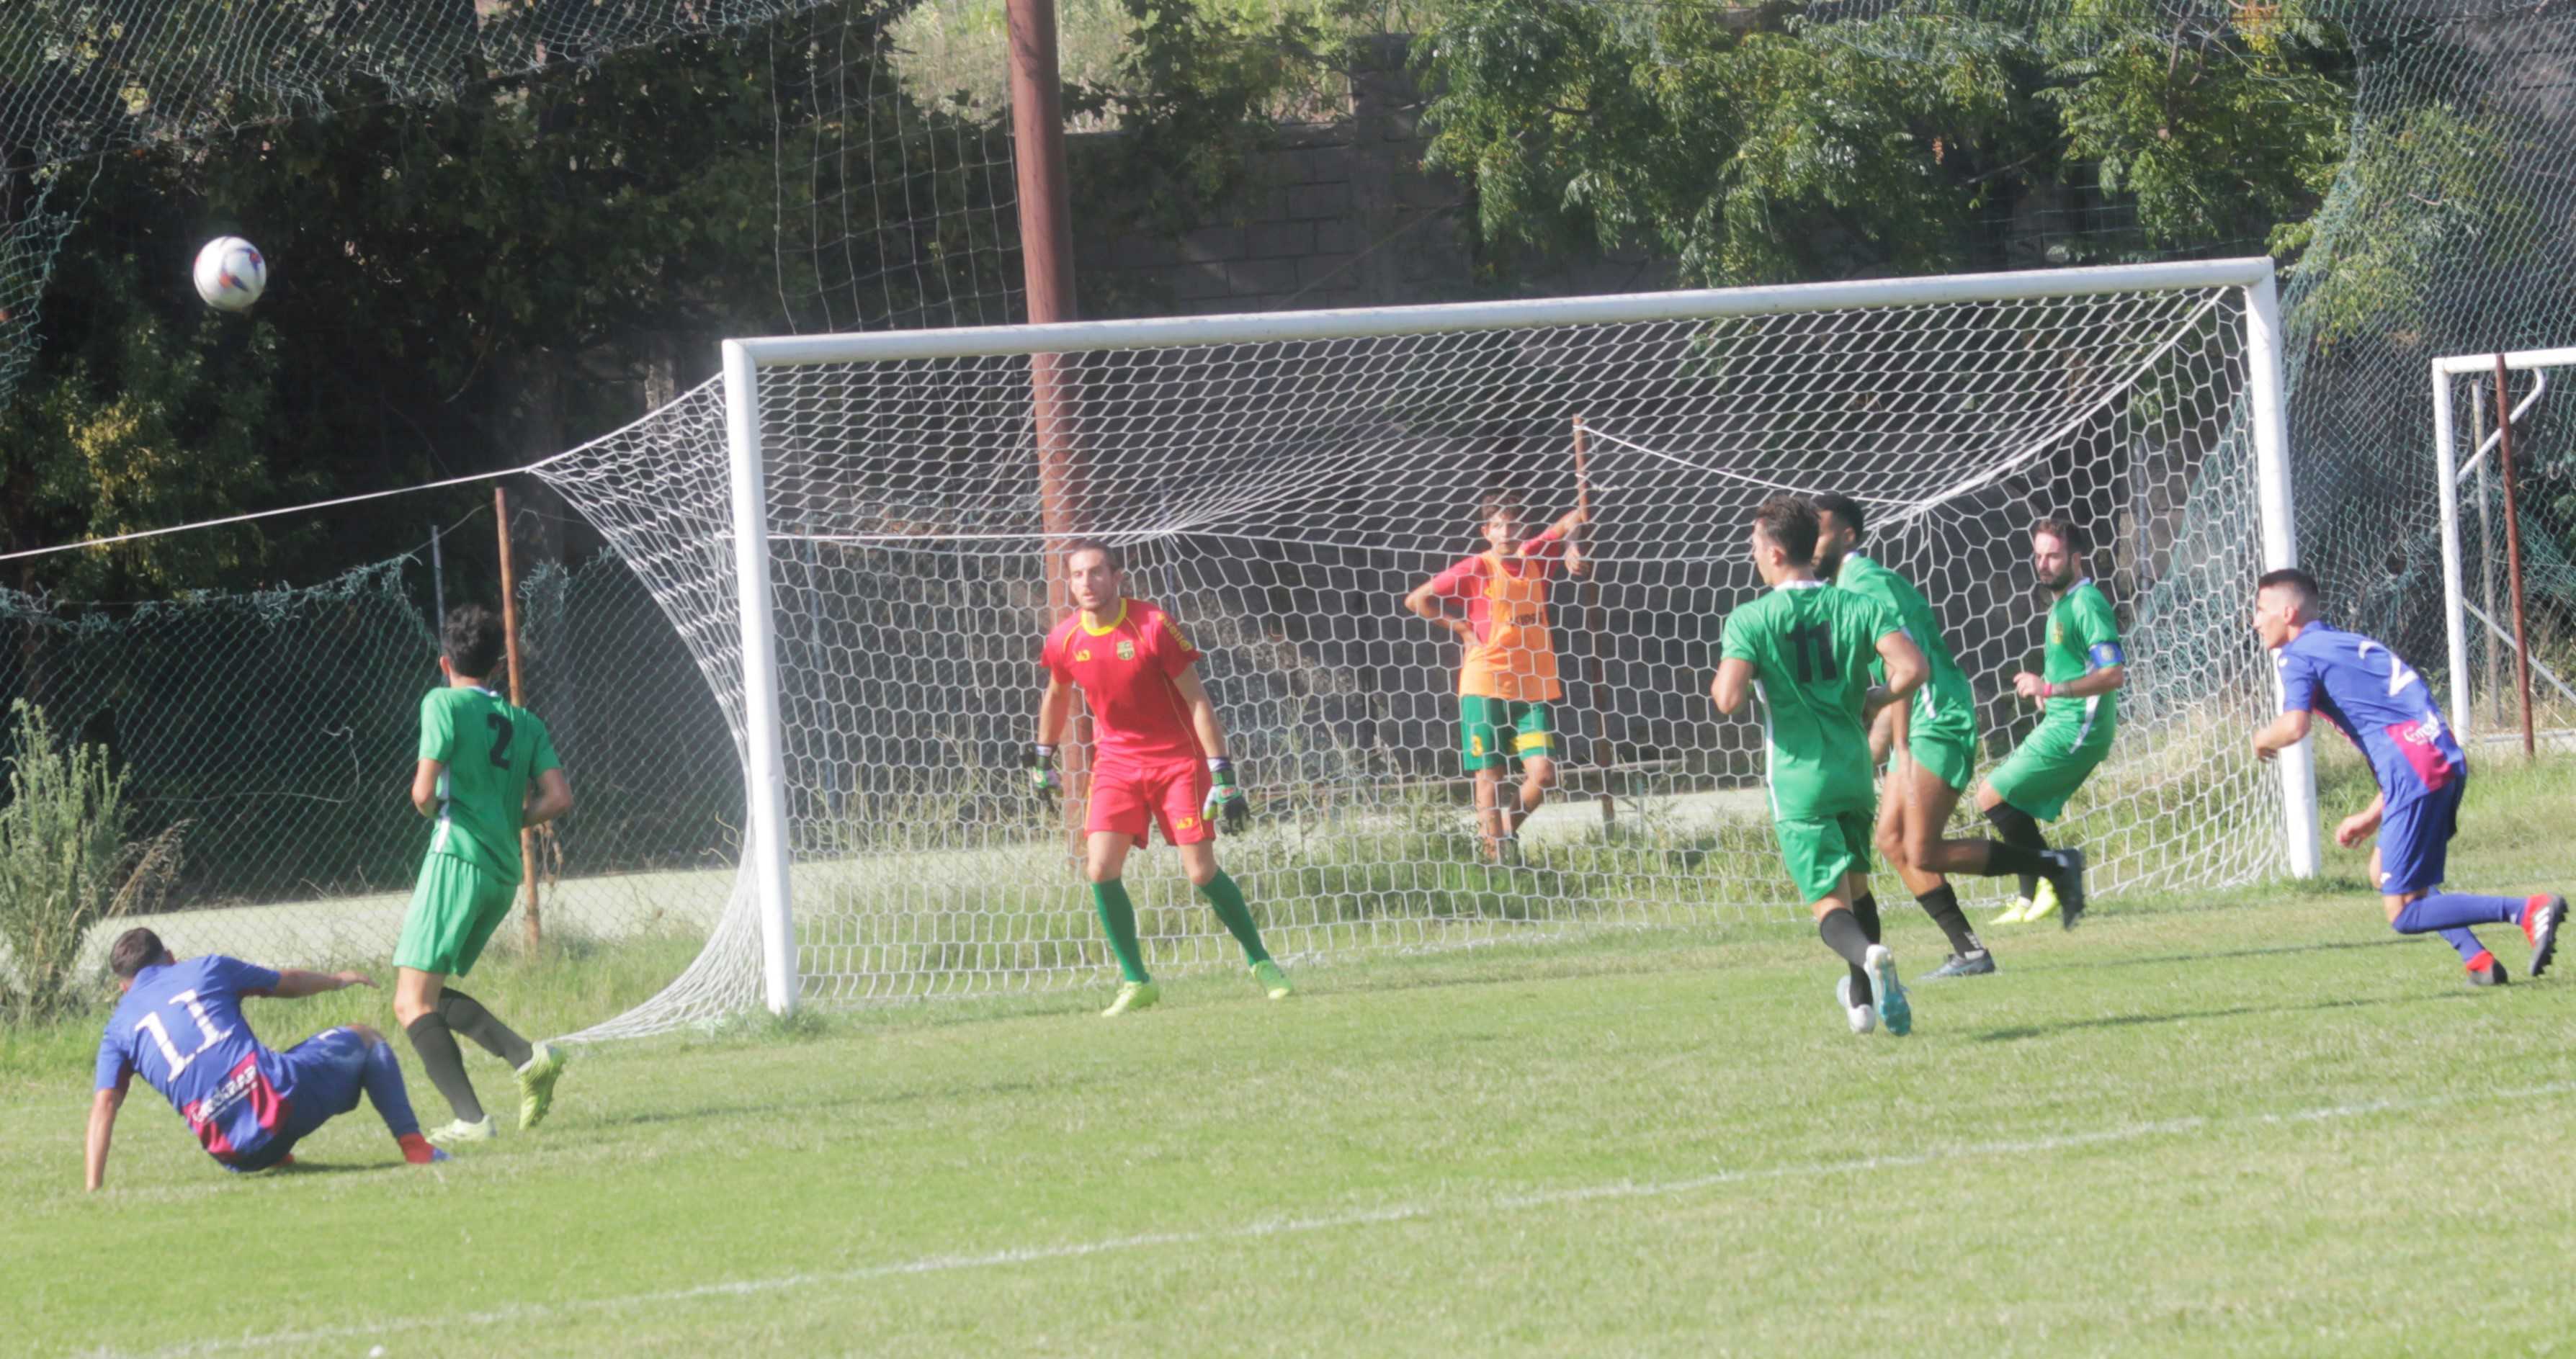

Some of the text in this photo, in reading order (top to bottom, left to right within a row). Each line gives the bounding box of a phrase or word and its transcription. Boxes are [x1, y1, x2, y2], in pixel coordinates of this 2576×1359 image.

[1785, 619, 1838, 683] 11
[2358, 640, 2420, 697] 2
[487, 712, 514, 771] 2
[134, 988, 233, 1082] 11
